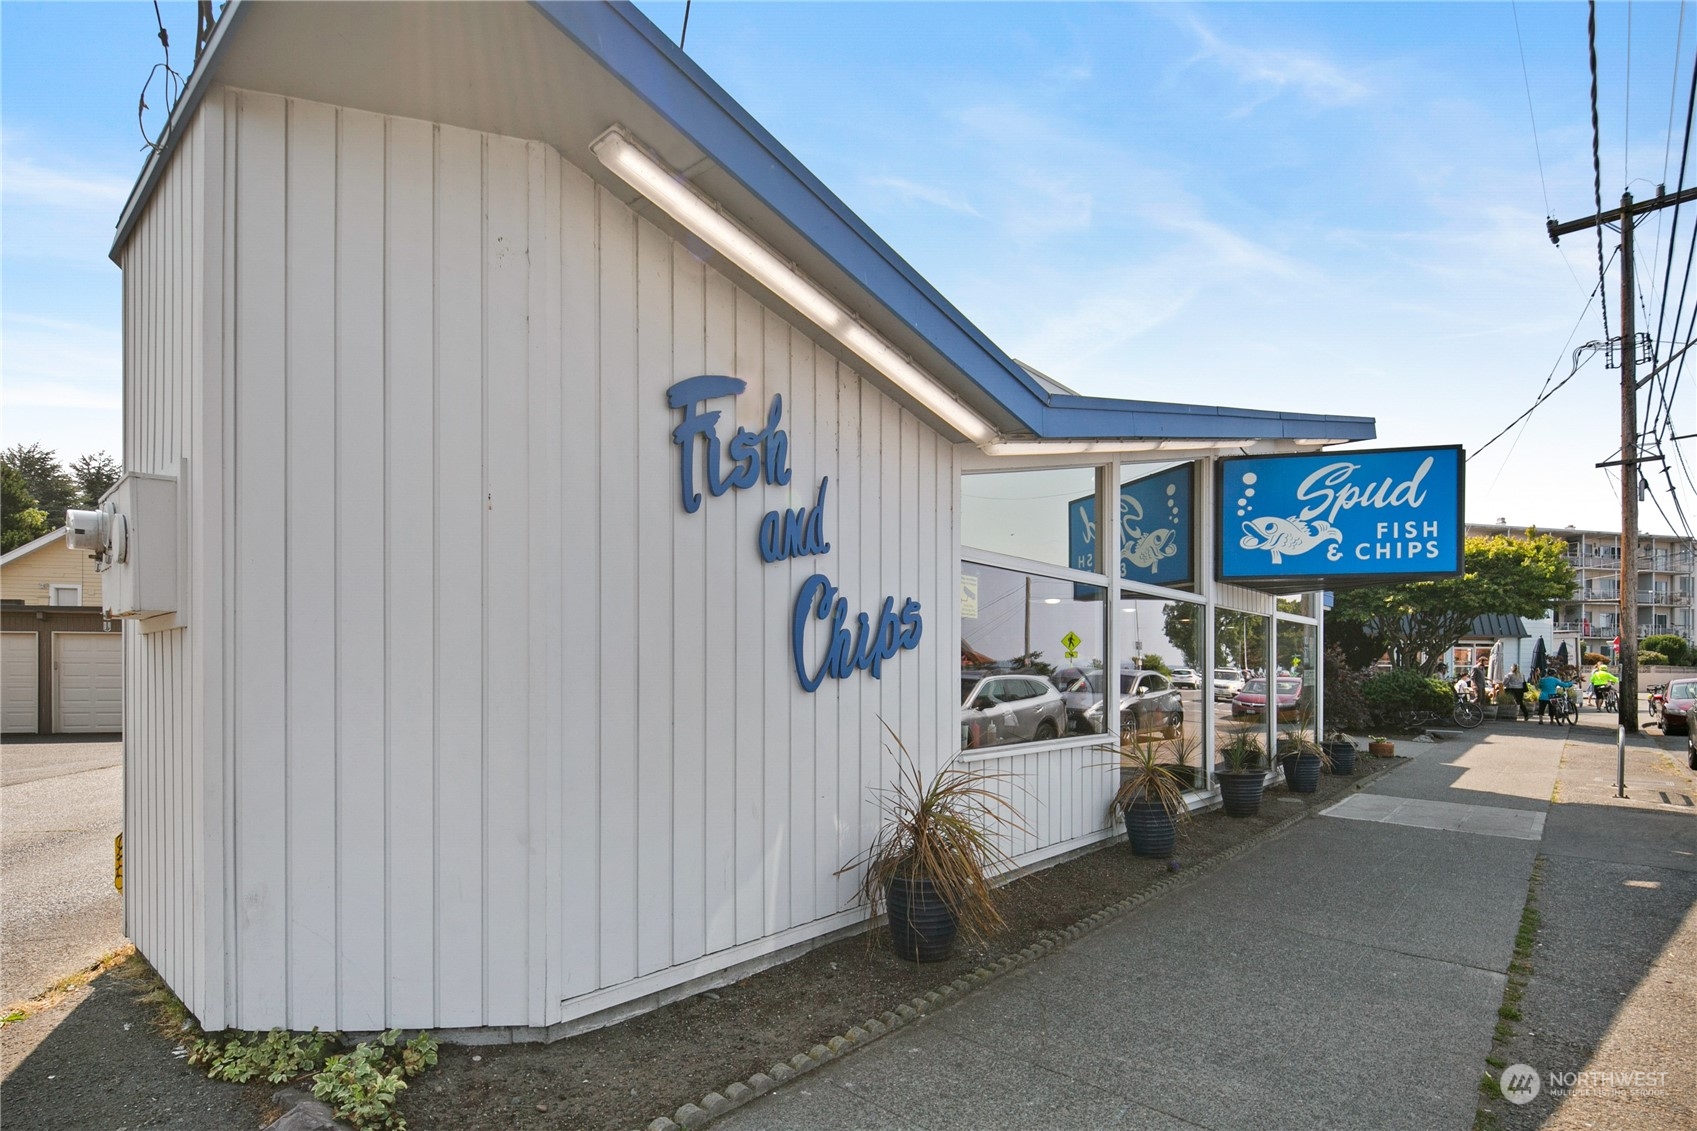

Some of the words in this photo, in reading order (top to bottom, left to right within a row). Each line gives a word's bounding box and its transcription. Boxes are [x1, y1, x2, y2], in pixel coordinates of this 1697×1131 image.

[666, 375, 792, 513] Fish
[759, 476, 831, 563] and
[1297, 456, 1434, 524] Spud
[1327, 543, 1344, 562] &
[1355, 540, 1439, 560] CHIPS
[1377, 521, 1438, 539] FISH
[792, 574, 923, 693] Chips
